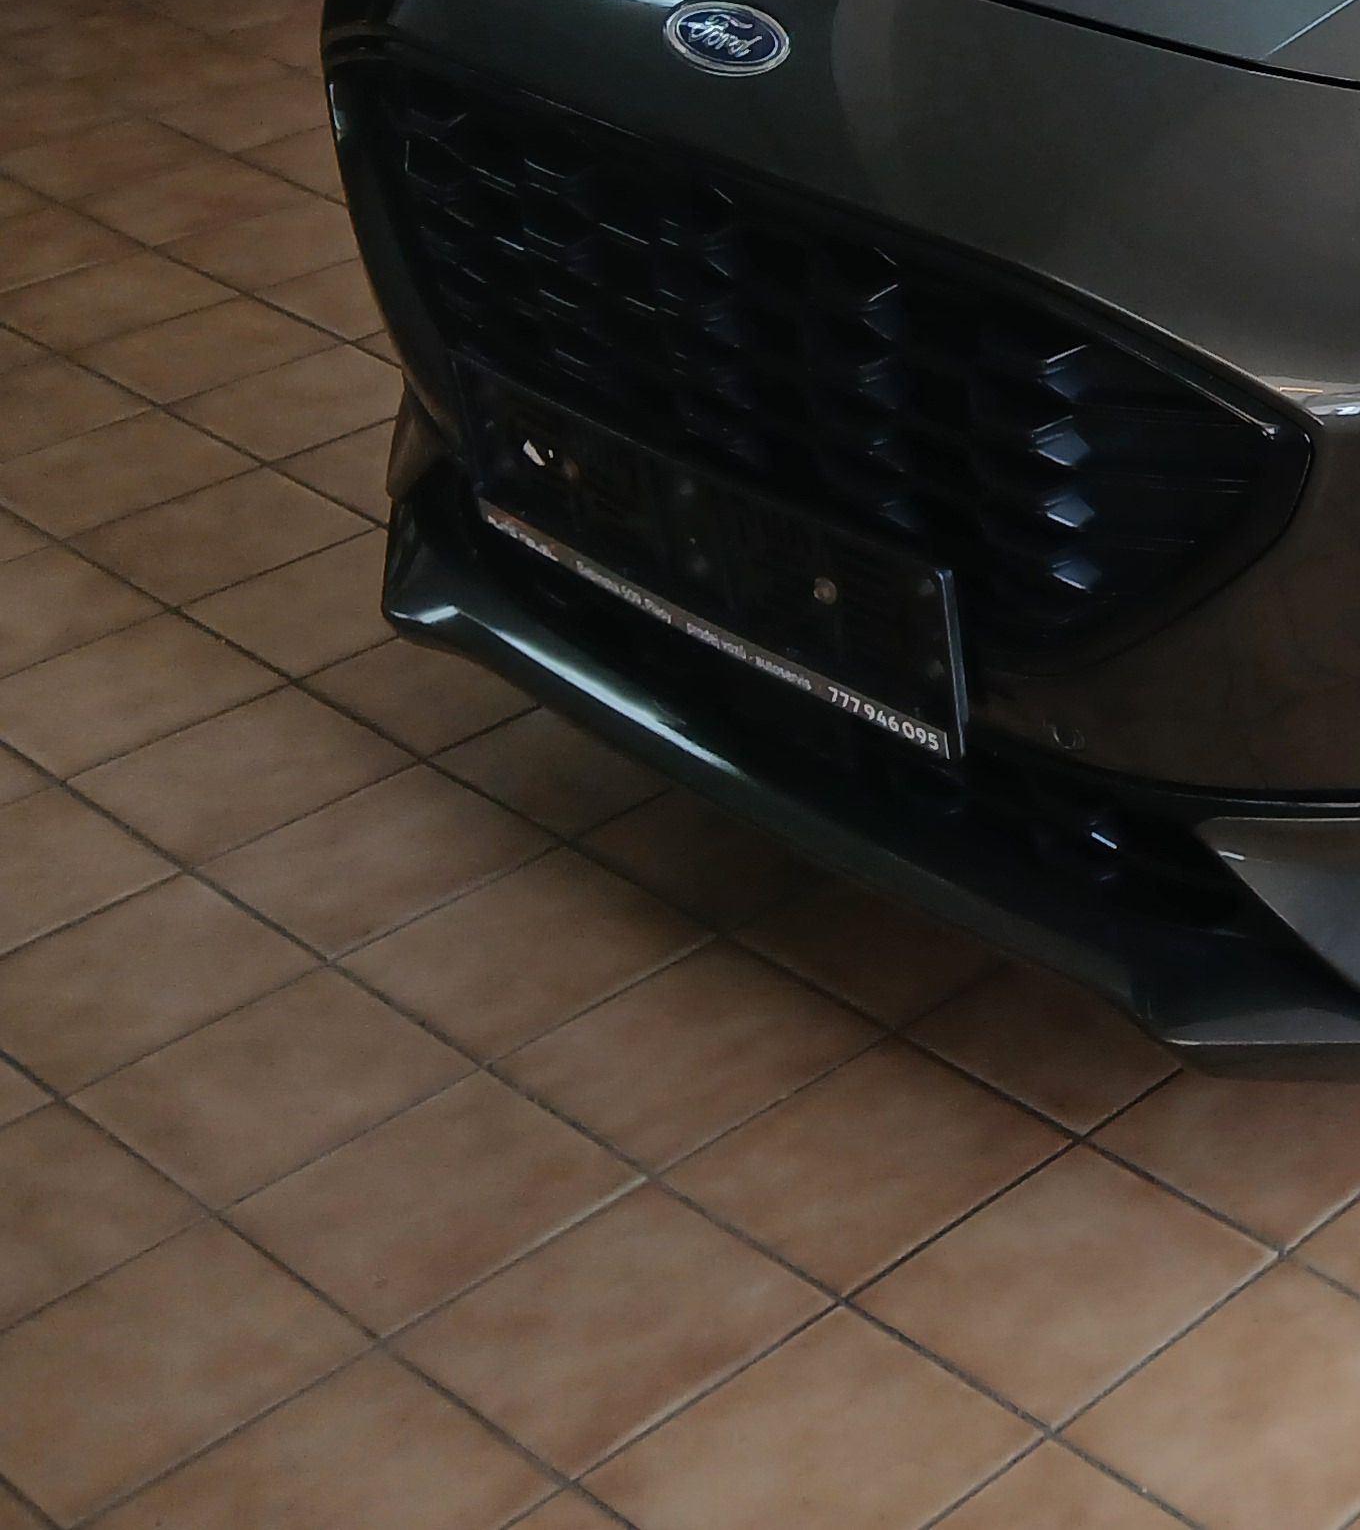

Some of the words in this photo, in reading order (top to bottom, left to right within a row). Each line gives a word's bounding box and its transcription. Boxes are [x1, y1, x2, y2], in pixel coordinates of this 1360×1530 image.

[686, 13, 763, 58] Ford
[827, 685, 861, 713] 777
[863, 703, 900, 733] 946
[901, 721, 940, 751] 095
